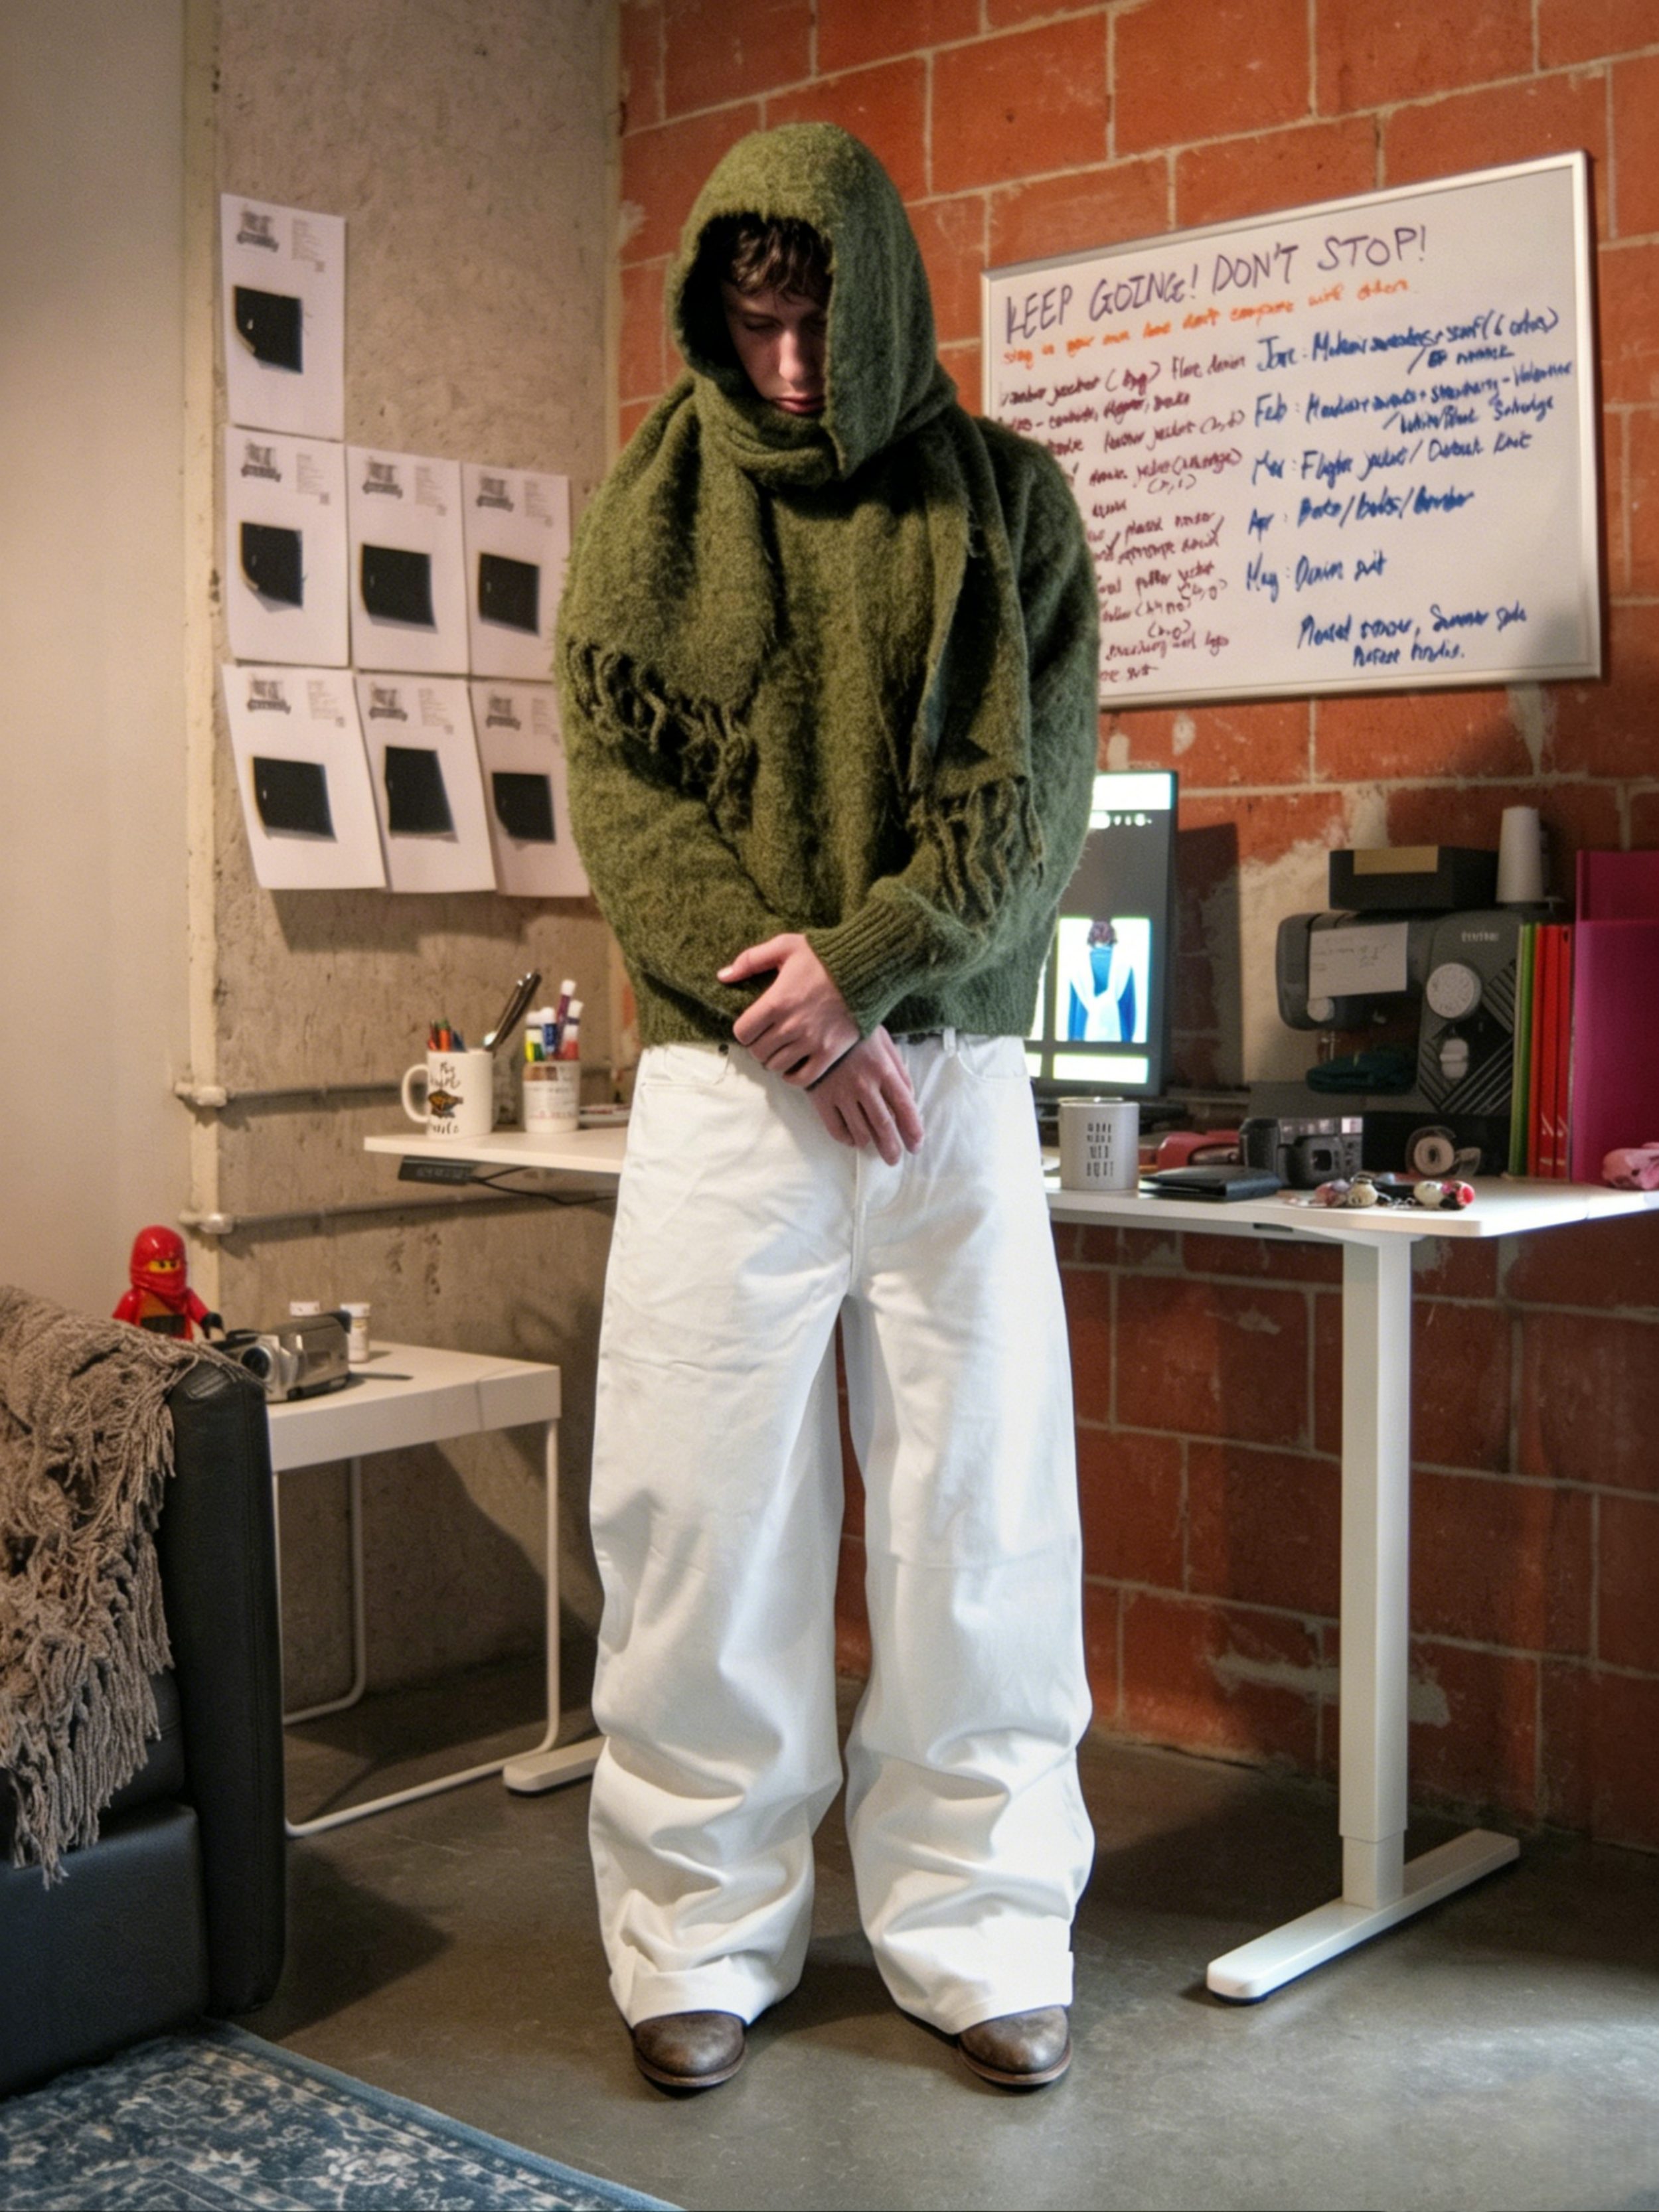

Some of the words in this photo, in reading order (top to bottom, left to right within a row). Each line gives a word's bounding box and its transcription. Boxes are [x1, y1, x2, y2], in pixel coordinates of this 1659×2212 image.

[1006, 284, 1073, 344] KEEP
[1089, 263, 1198, 321] GOING!
[1212, 242, 1299, 295] DON'T
[1317, 224, 1426, 271] STOP!
